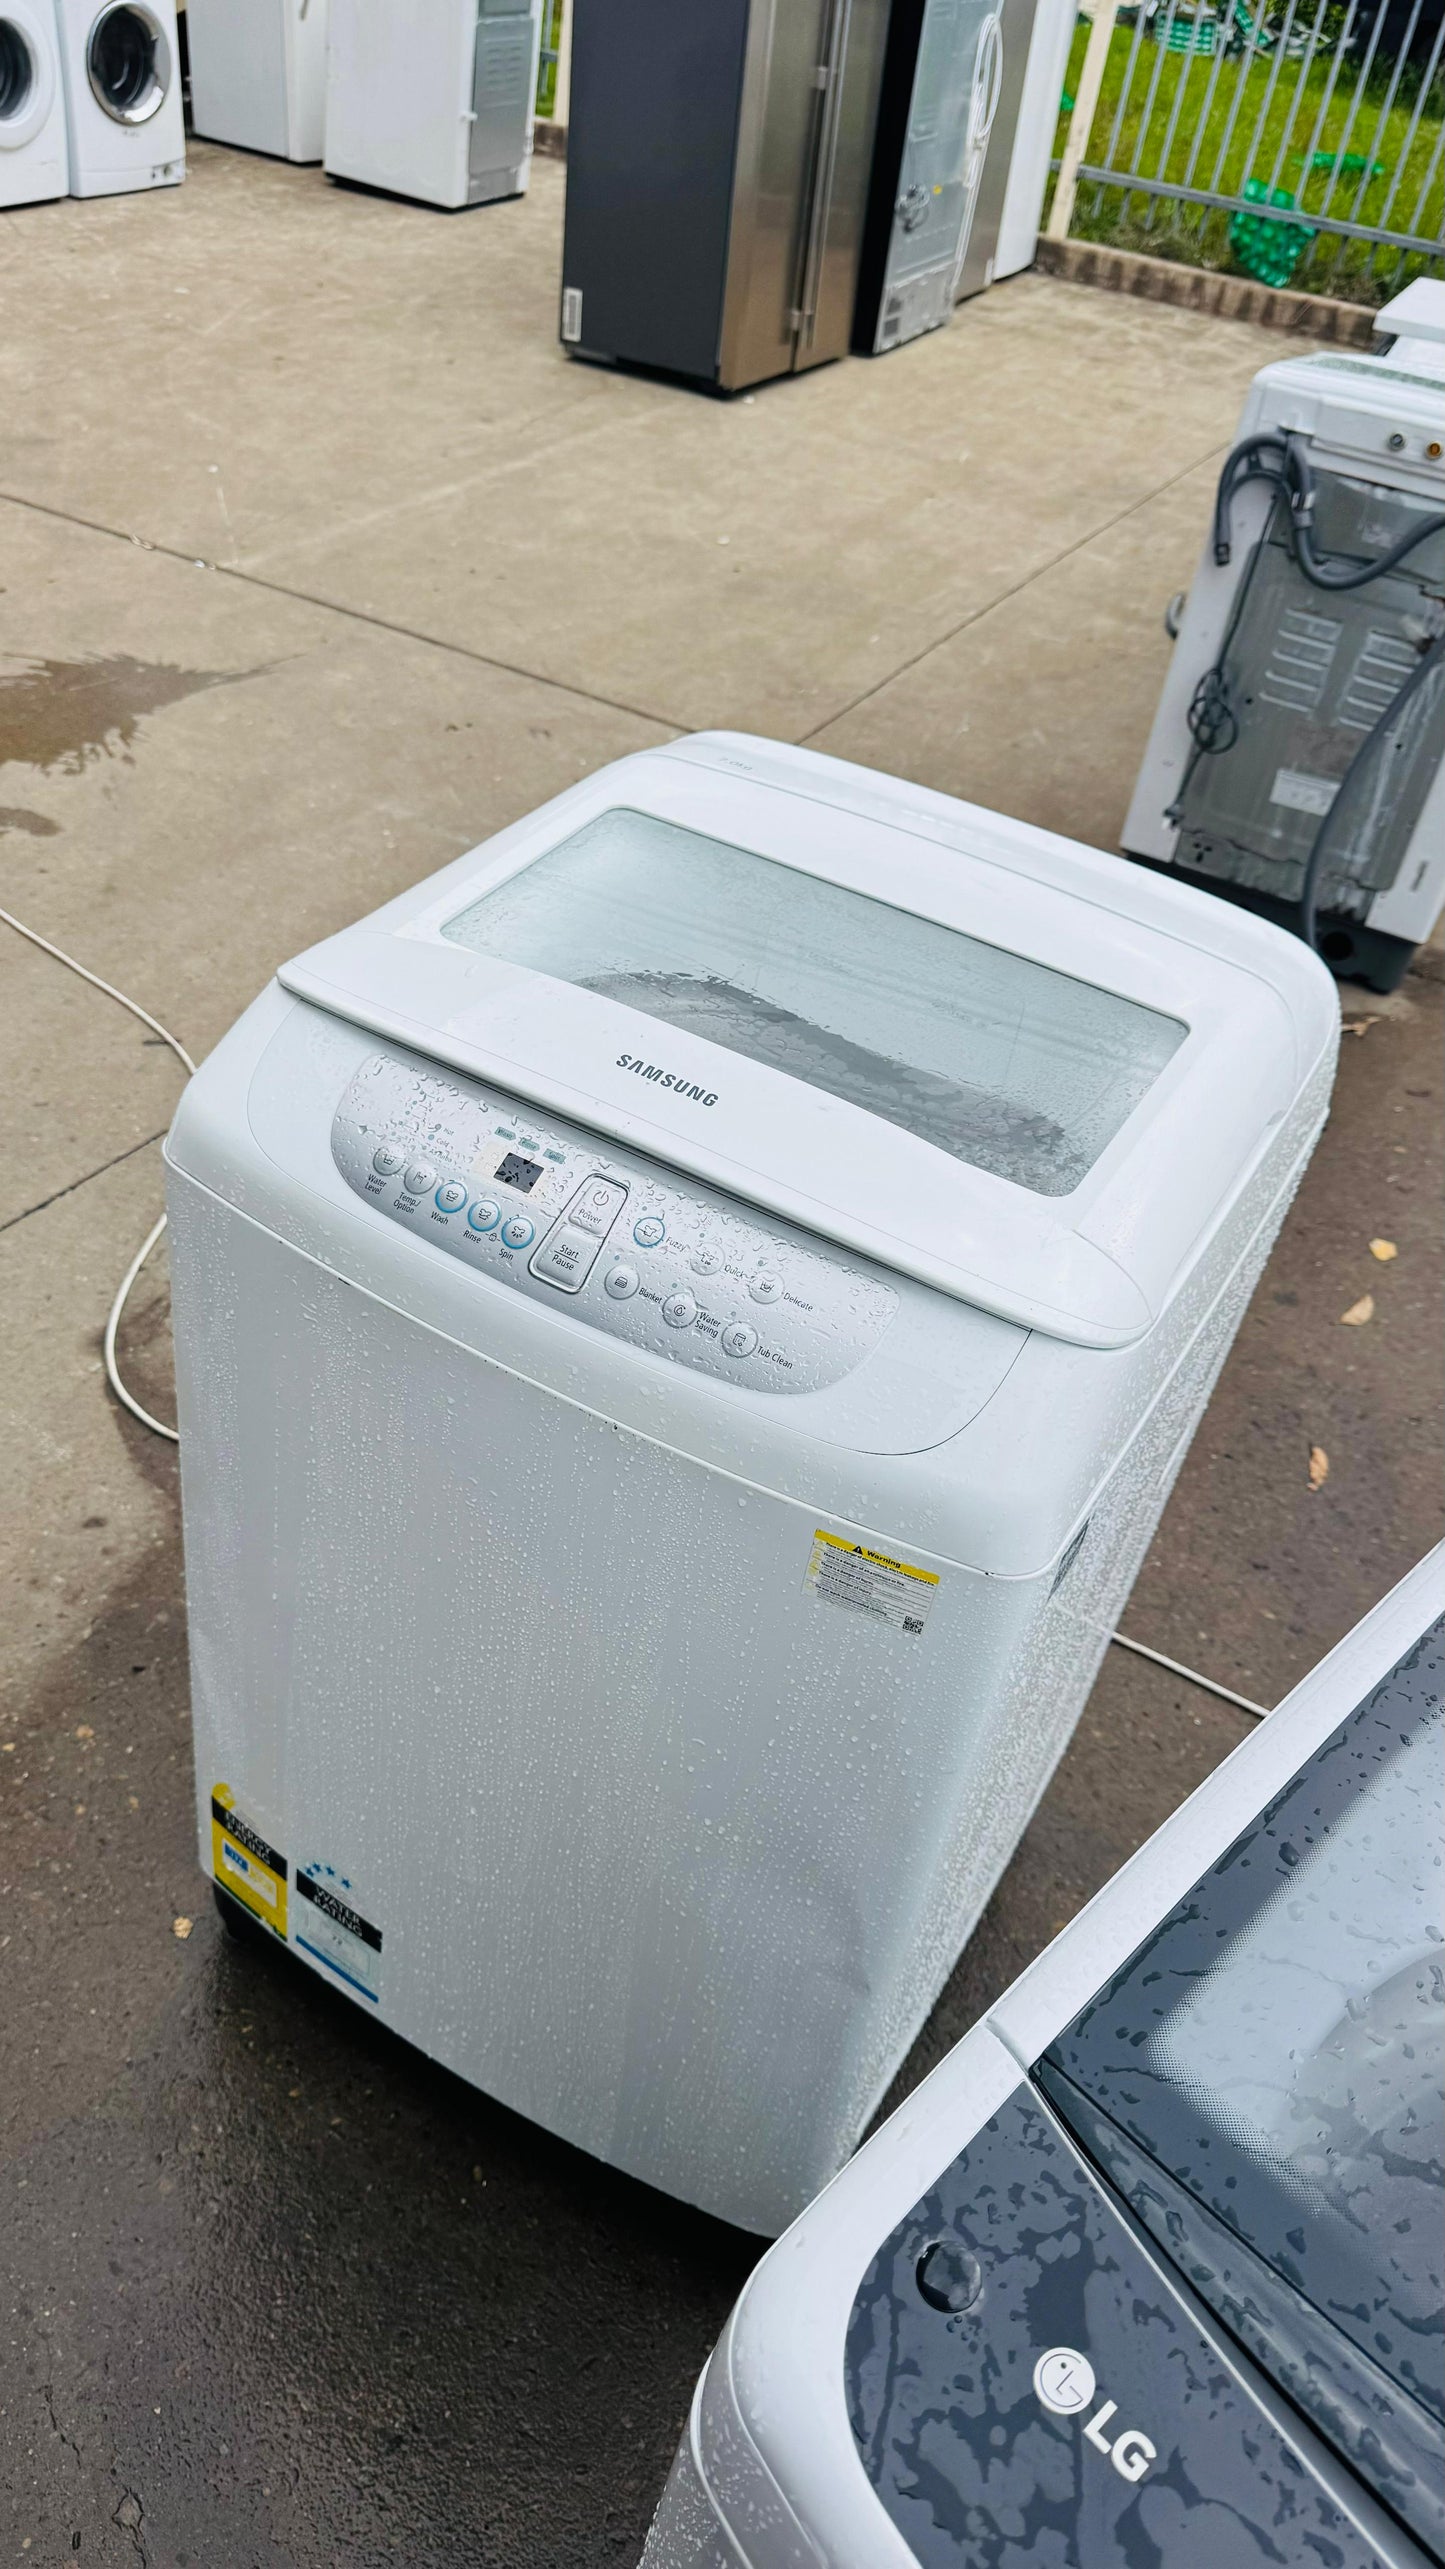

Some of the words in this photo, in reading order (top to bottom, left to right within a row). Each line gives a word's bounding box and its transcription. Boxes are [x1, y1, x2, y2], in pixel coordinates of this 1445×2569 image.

[616, 1054, 719, 1107] SAMSUNG
[365, 1182, 382, 1195] Level
[368, 1174, 387, 1188] Water
[393, 1199, 415, 1215] Option
[430, 1210, 449, 1225] Wash
[578, 1208, 602, 1225] Power
[463, 1229, 482, 1244] Rinse
[665, 1236, 687, 1252] Fuzzy
[498, 1248, 514, 1261] Spin
[559, 1244, 580, 1259] Start
[551, 1254, 575, 1271] Pause
[724, 1264, 744, 1279] Quick
[638, 1287, 662, 1305] Blanket
[783, 1292, 814, 1312] Delicate
[699, 1312, 721, 1328] Water
[695, 1320, 719, 1339] Saving
[757, 1345, 771, 1359] Tub
[771, 1353, 793, 1370] Clean
[867, 1550, 901, 1569] Warning
[227, 1823, 271, 1866] RATING
[315, 1885, 361, 1926] WATER
[313, 1894, 363, 1937] RATING
[1083, 2399, 1157, 2482] LG
